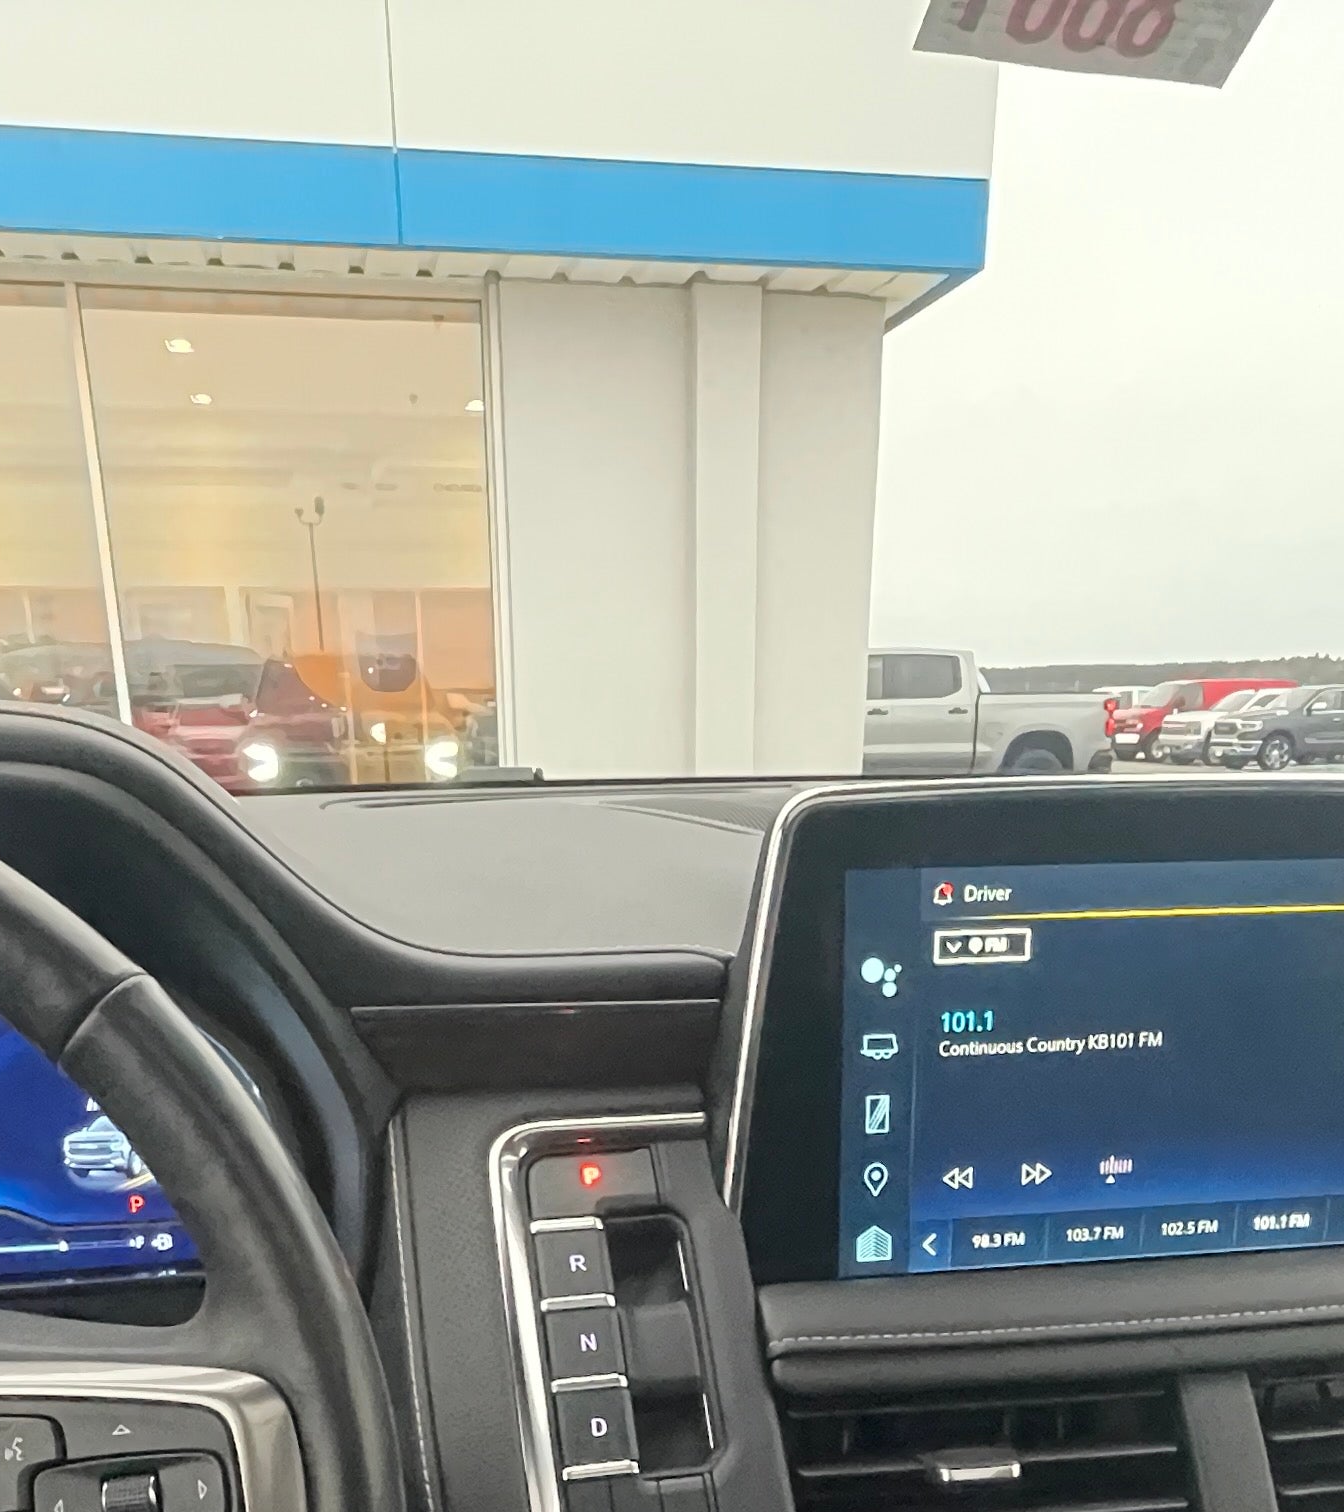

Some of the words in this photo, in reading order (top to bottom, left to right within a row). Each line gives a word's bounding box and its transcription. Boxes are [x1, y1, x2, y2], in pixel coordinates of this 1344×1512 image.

[963, 884, 1013, 903] Driver
[940, 1009, 995, 1034] 101.1
[938, 1039, 1024, 1058] Continuous
[1026, 1035, 1086, 1056] Country
[1087, 1031, 1135, 1051] KB101
[1138, 1031, 1164, 1048] FM
[580, 1164, 602, 1187] P
[128, 1193, 145, 1214] P
[1066, 1226, 1101, 1242] 103.7
[1103, 1225, 1124, 1240] FM
[1161, 1220, 1195, 1236] 102.5
[1197, 1219, 1218, 1234] FM
[568, 1254, 588, 1273] R
[579, 1332, 599, 1353] N
[590, 1417, 608, 1437] D
